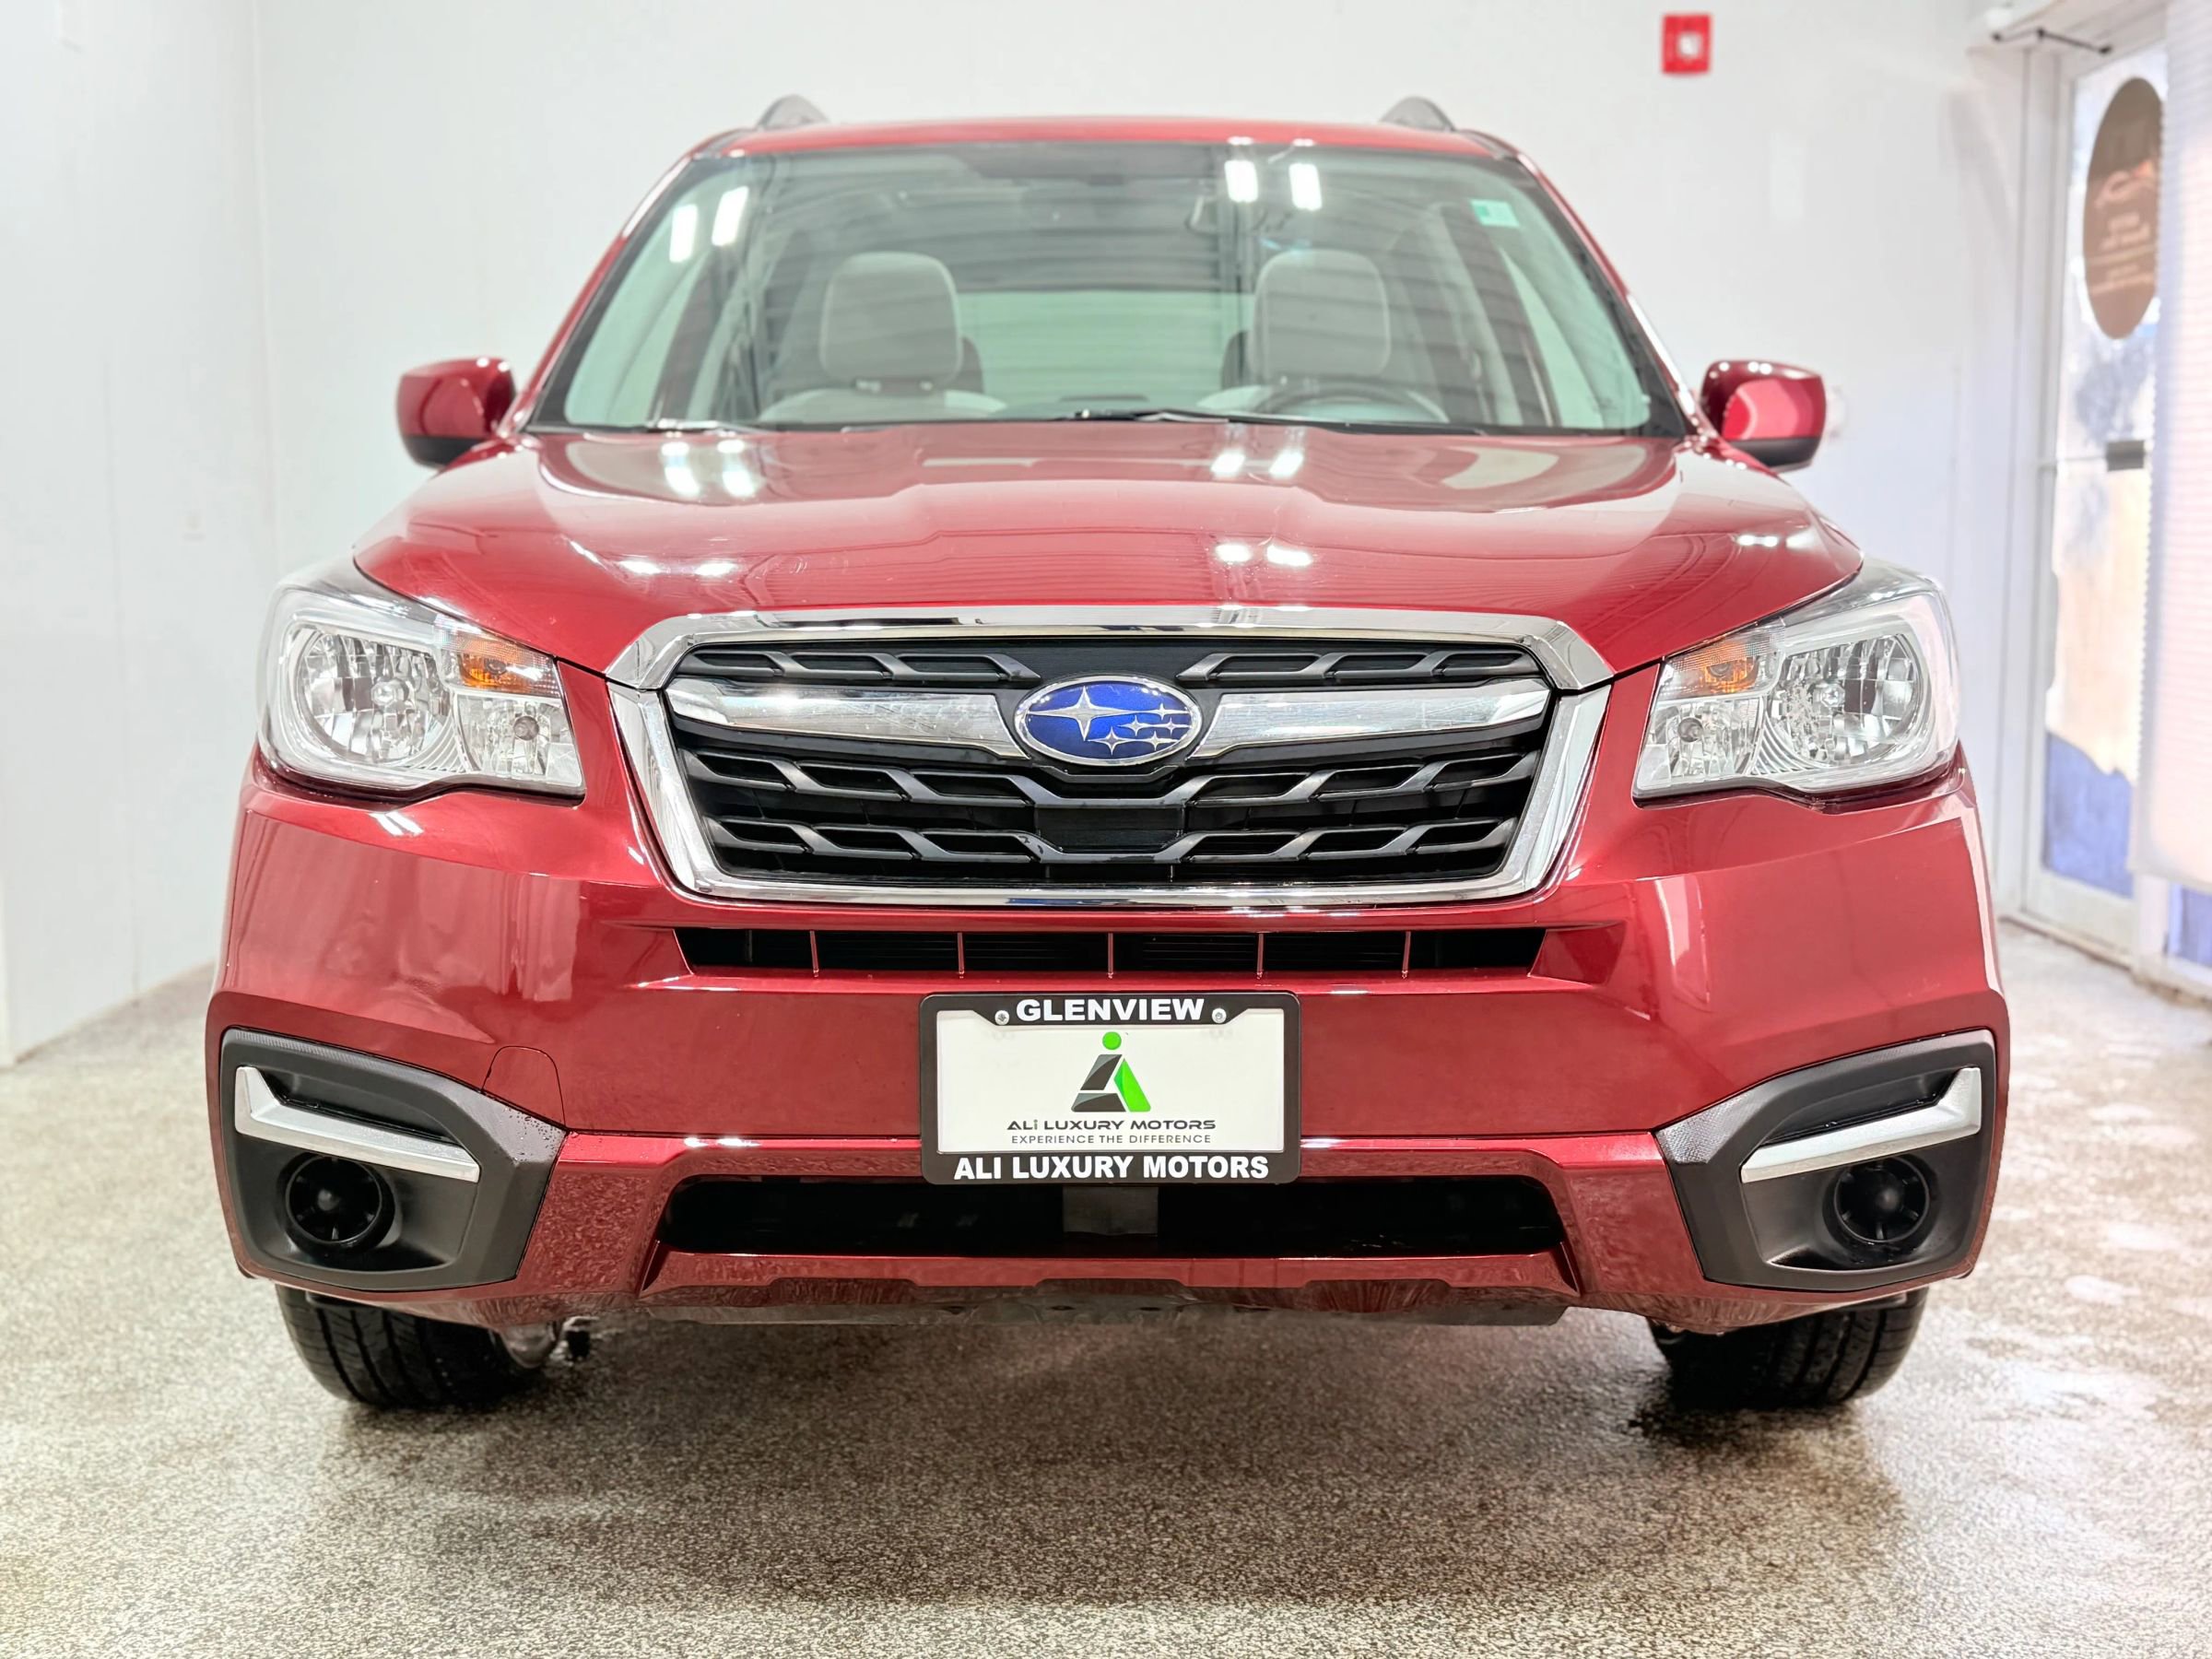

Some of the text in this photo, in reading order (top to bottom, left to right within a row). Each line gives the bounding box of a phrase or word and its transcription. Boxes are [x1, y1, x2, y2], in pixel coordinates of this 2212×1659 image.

[1017, 999, 1204, 1021] GLENVIEW
[1044, 1121, 1123, 1130] LUXURY
[1131, 1121, 1216, 1130] MOTORS
[1011, 1135, 1210, 1144] EXPERIENCE THE DIFFERENCE
[954, 1156, 1268, 1180] ALI LUXURY MOTORS
